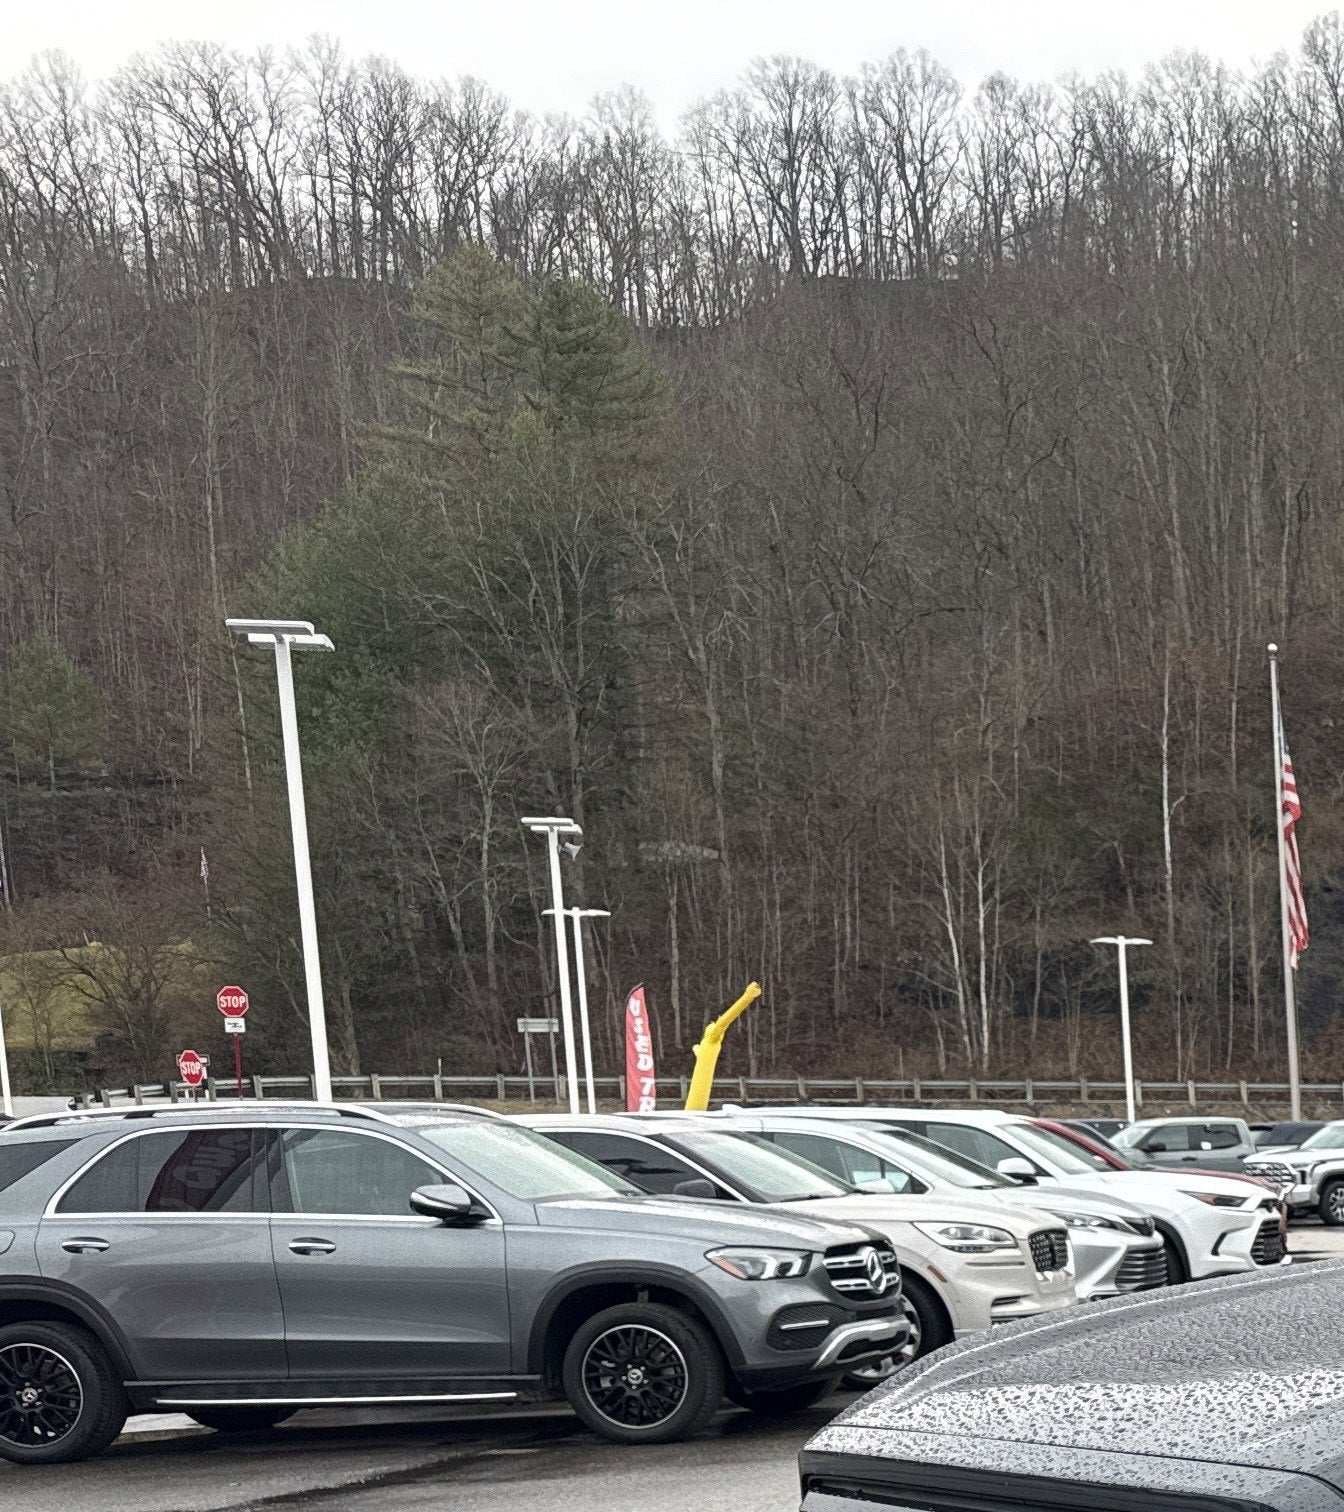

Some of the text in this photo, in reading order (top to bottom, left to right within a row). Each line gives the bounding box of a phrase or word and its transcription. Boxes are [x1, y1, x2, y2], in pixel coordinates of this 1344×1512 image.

[220, 996, 246, 1008] STOP
[628, 997, 654, 1071] USED
[181, 1061, 201, 1075] STOP
